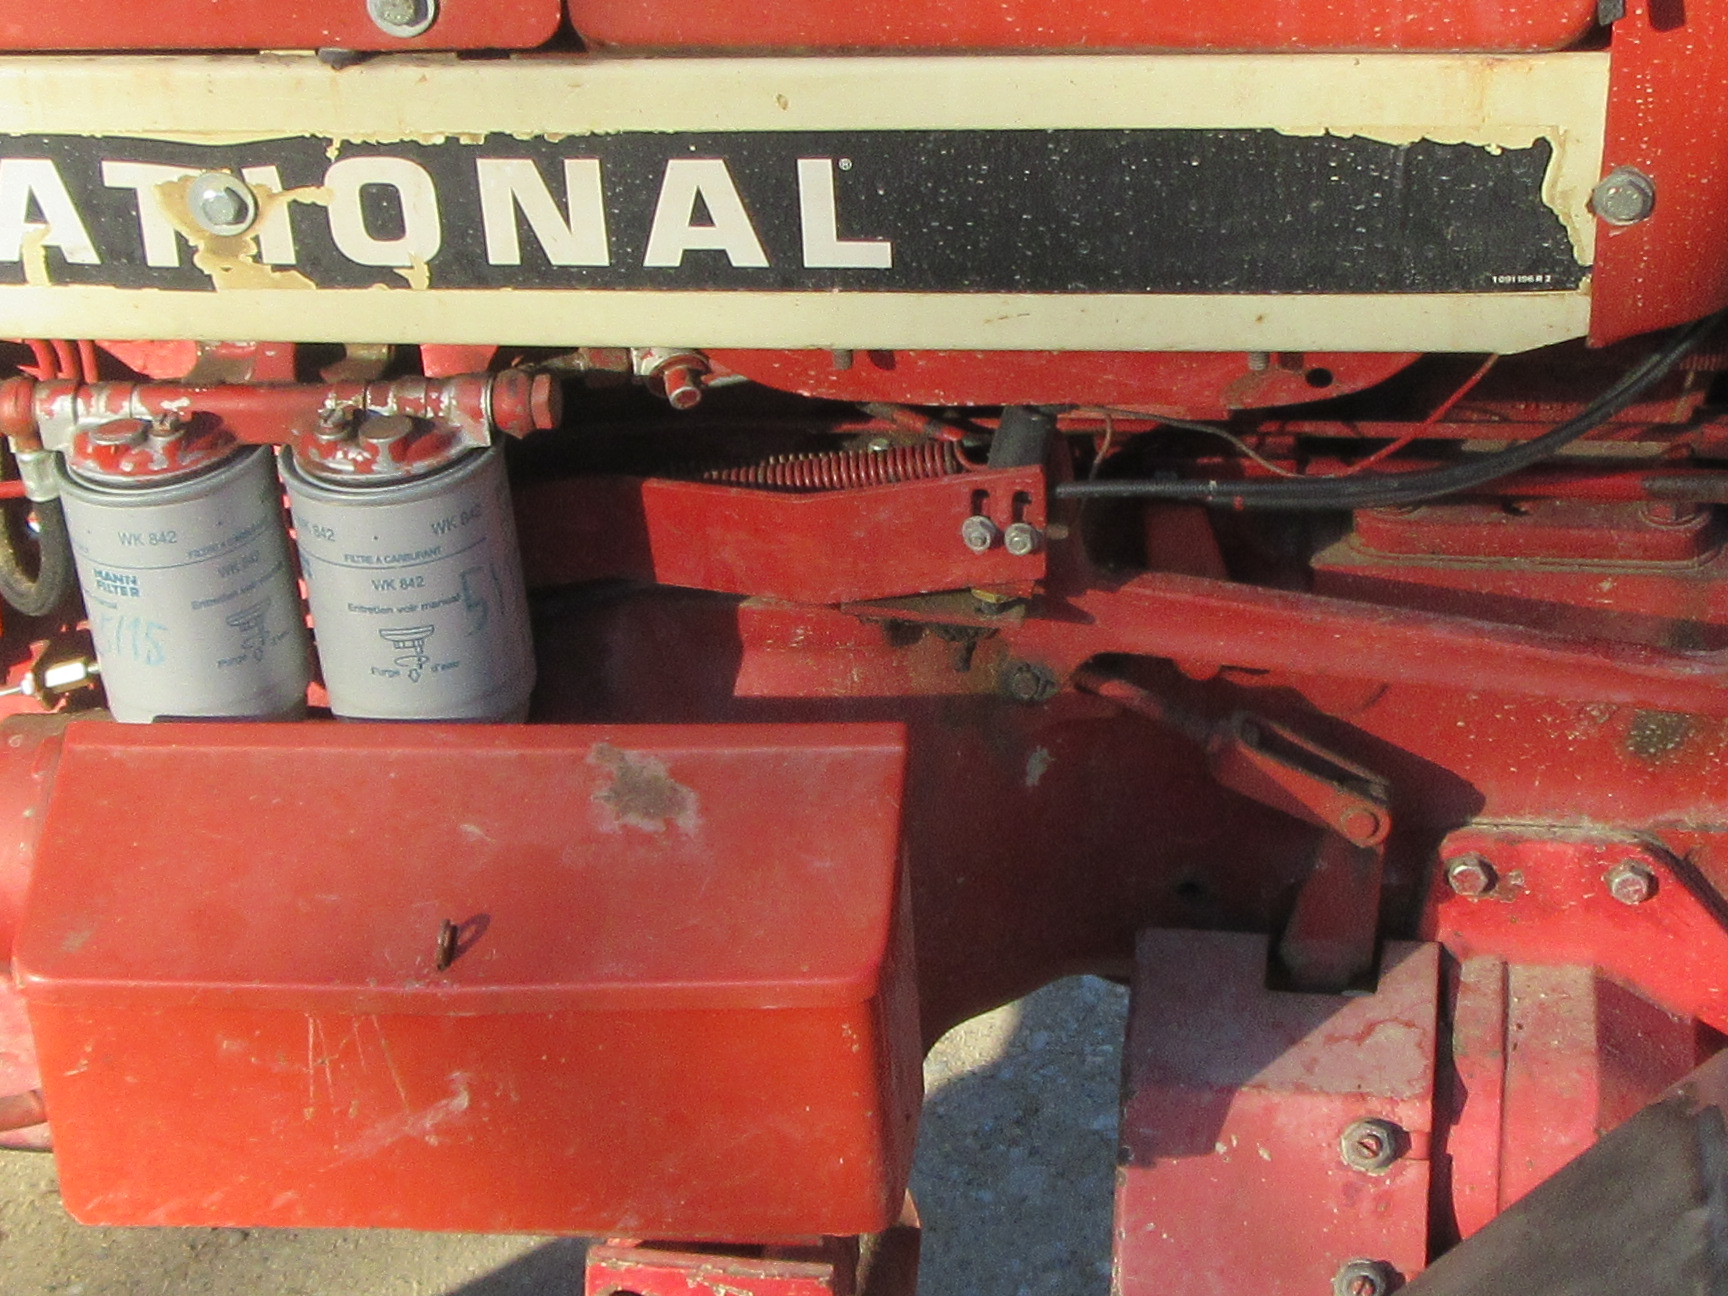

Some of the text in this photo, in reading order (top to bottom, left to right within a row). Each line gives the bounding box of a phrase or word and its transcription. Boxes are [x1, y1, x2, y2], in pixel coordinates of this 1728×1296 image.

[431, 515, 458, 534] WK
[118, 530, 178, 546] WK 842
[95, 580, 140, 598] FILTER
[371, 575, 426, 592] WK 842
